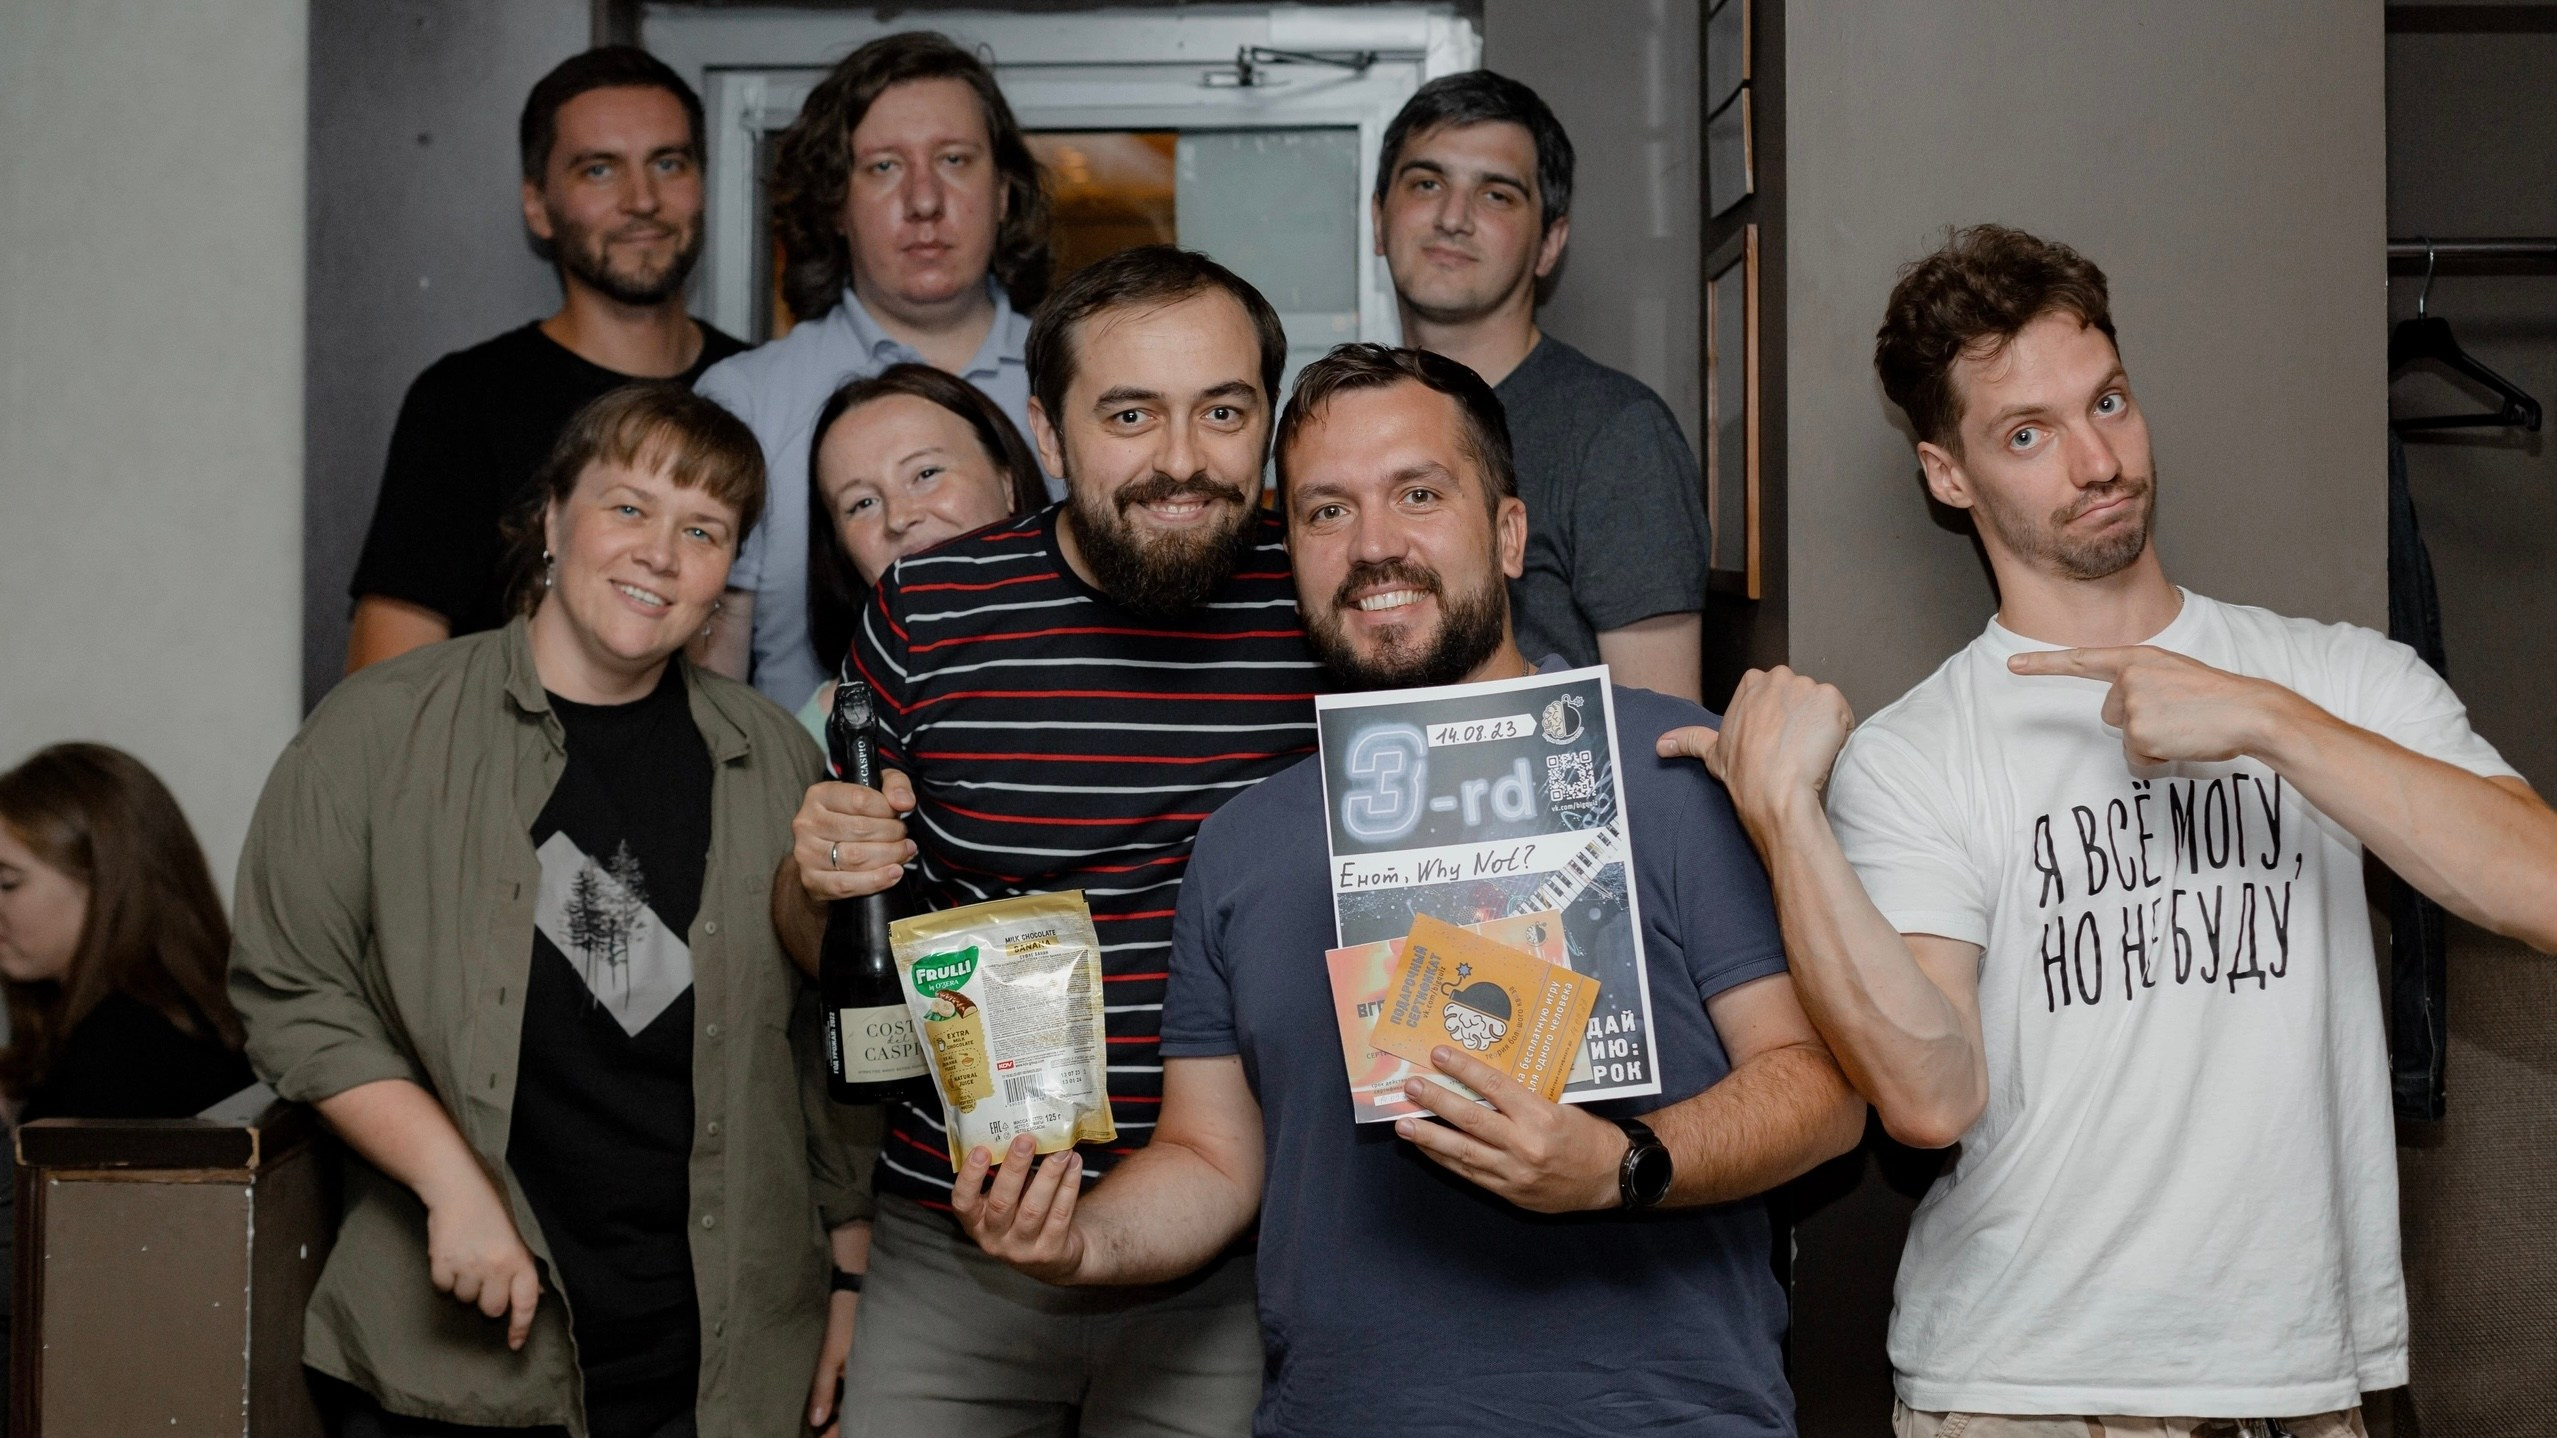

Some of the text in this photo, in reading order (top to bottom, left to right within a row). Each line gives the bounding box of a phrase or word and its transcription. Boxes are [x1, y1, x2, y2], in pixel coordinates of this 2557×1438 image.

[1435, 720, 1517, 744] 14.08.23
[858, 740, 869, 777] CASPIO
[2034, 772, 2303, 908] Я ВСЁ МОГУ,
[1417, 856, 1461, 884] Why
[1474, 844, 1536, 875] Not?
[1005, 929, 1057, 945] MILK CHOCOLATE
[1013, 939, 1052, 954] BANANA
[2041, 881, 2291, 1013] НО НЕ БУДУ
[916, 959, 972, 985] FRULLI
[928, 984, 935, 992] by
[1390, 944, 1428, 1026] ПОДАРОЧНЫЙ
[1406, 952, 1442, 1028] СЕРТИФИКАТ
[1423, 966, 1446, 1019] vk.com/bigquiz
[1508, 986, 1523, 1008] квза
[947, 1029, 970, 1039] EXTRA
[1520, 1007, 1550, 1070] бесплатную
[1546, 980, 1561, 1005] игру
[1535, 1034, 1554, 1072] одного
[1550, 982, 1573, 1031] человека
[1586, 1010, 1636, 1040] ДАЙ
[865, 1042, 921, 1062] CASPI
[946, 1040, 974, 1050] CHOCOLATE
[1590, 1038, 1639, 1060] ИЮ:
[954, 1072, 978, 1081] NATURAL
[997, 1062, 1013, 1070] KDV
[1593, 1061, 1642, 1085] РОК
[1045, 1113, 1057, 1122] 125
